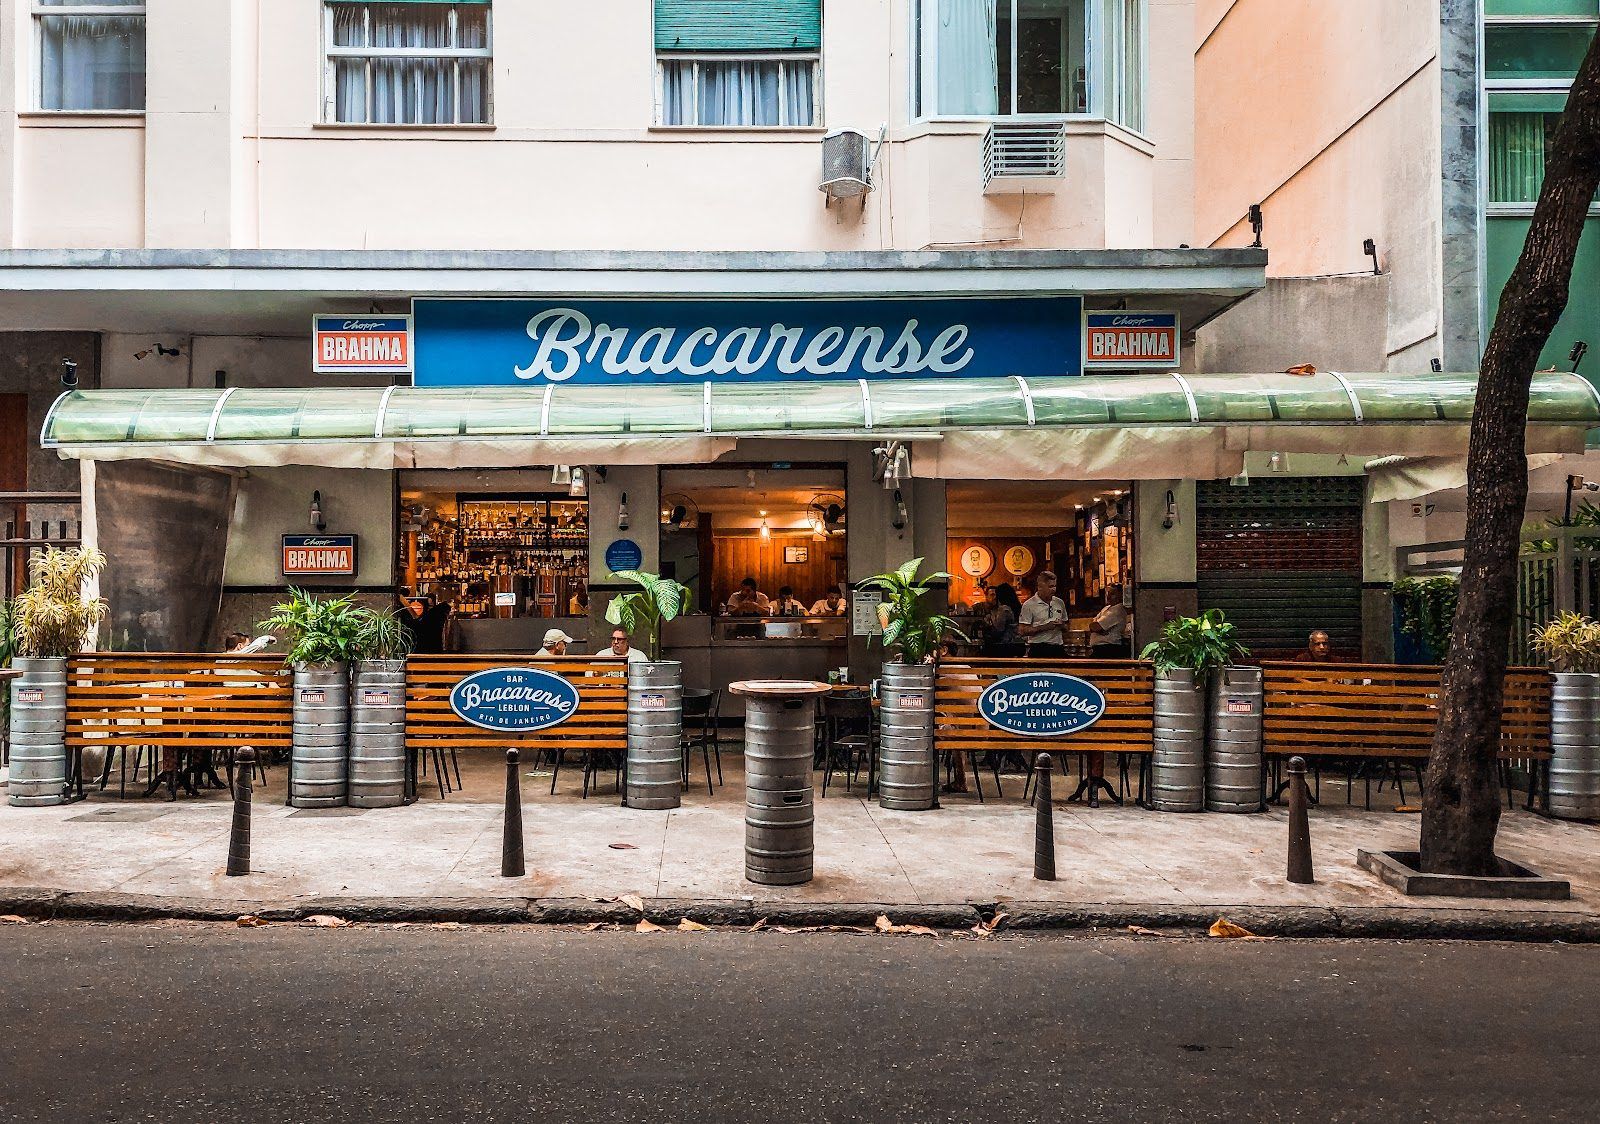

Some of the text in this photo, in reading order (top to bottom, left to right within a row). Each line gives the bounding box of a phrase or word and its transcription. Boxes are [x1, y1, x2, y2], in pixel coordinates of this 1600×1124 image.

[342, 320, 385, 330] Chopp
[1112, 316, 1154, 326] Chopp
[322, 336, 403, 361] BRAHMA
[514, 307, 974, 382] Bracarense
[1092, 332, 1170, 356] BRAHMA
[303, 537, 336, 546] Chopp
[288, 550, 348, 568] BRAHMA
[506, 675, 523, 683] BAR
[1032, 680, 1050, 688] BAR
[460, 683, 572, 712] Bracarense
[988, 688, 1099, 716] Bracarense
[498, 704, 530, 712] LEBLON
[1025, 708, 1057, 717] LEBLON
[478, 713, 494, 723] RIO
[513, 714, 551, 724] JANEIRO
[1007, 718, 1022, 727] RIO
[1041, 718, 1078, 729] JANEIRO
